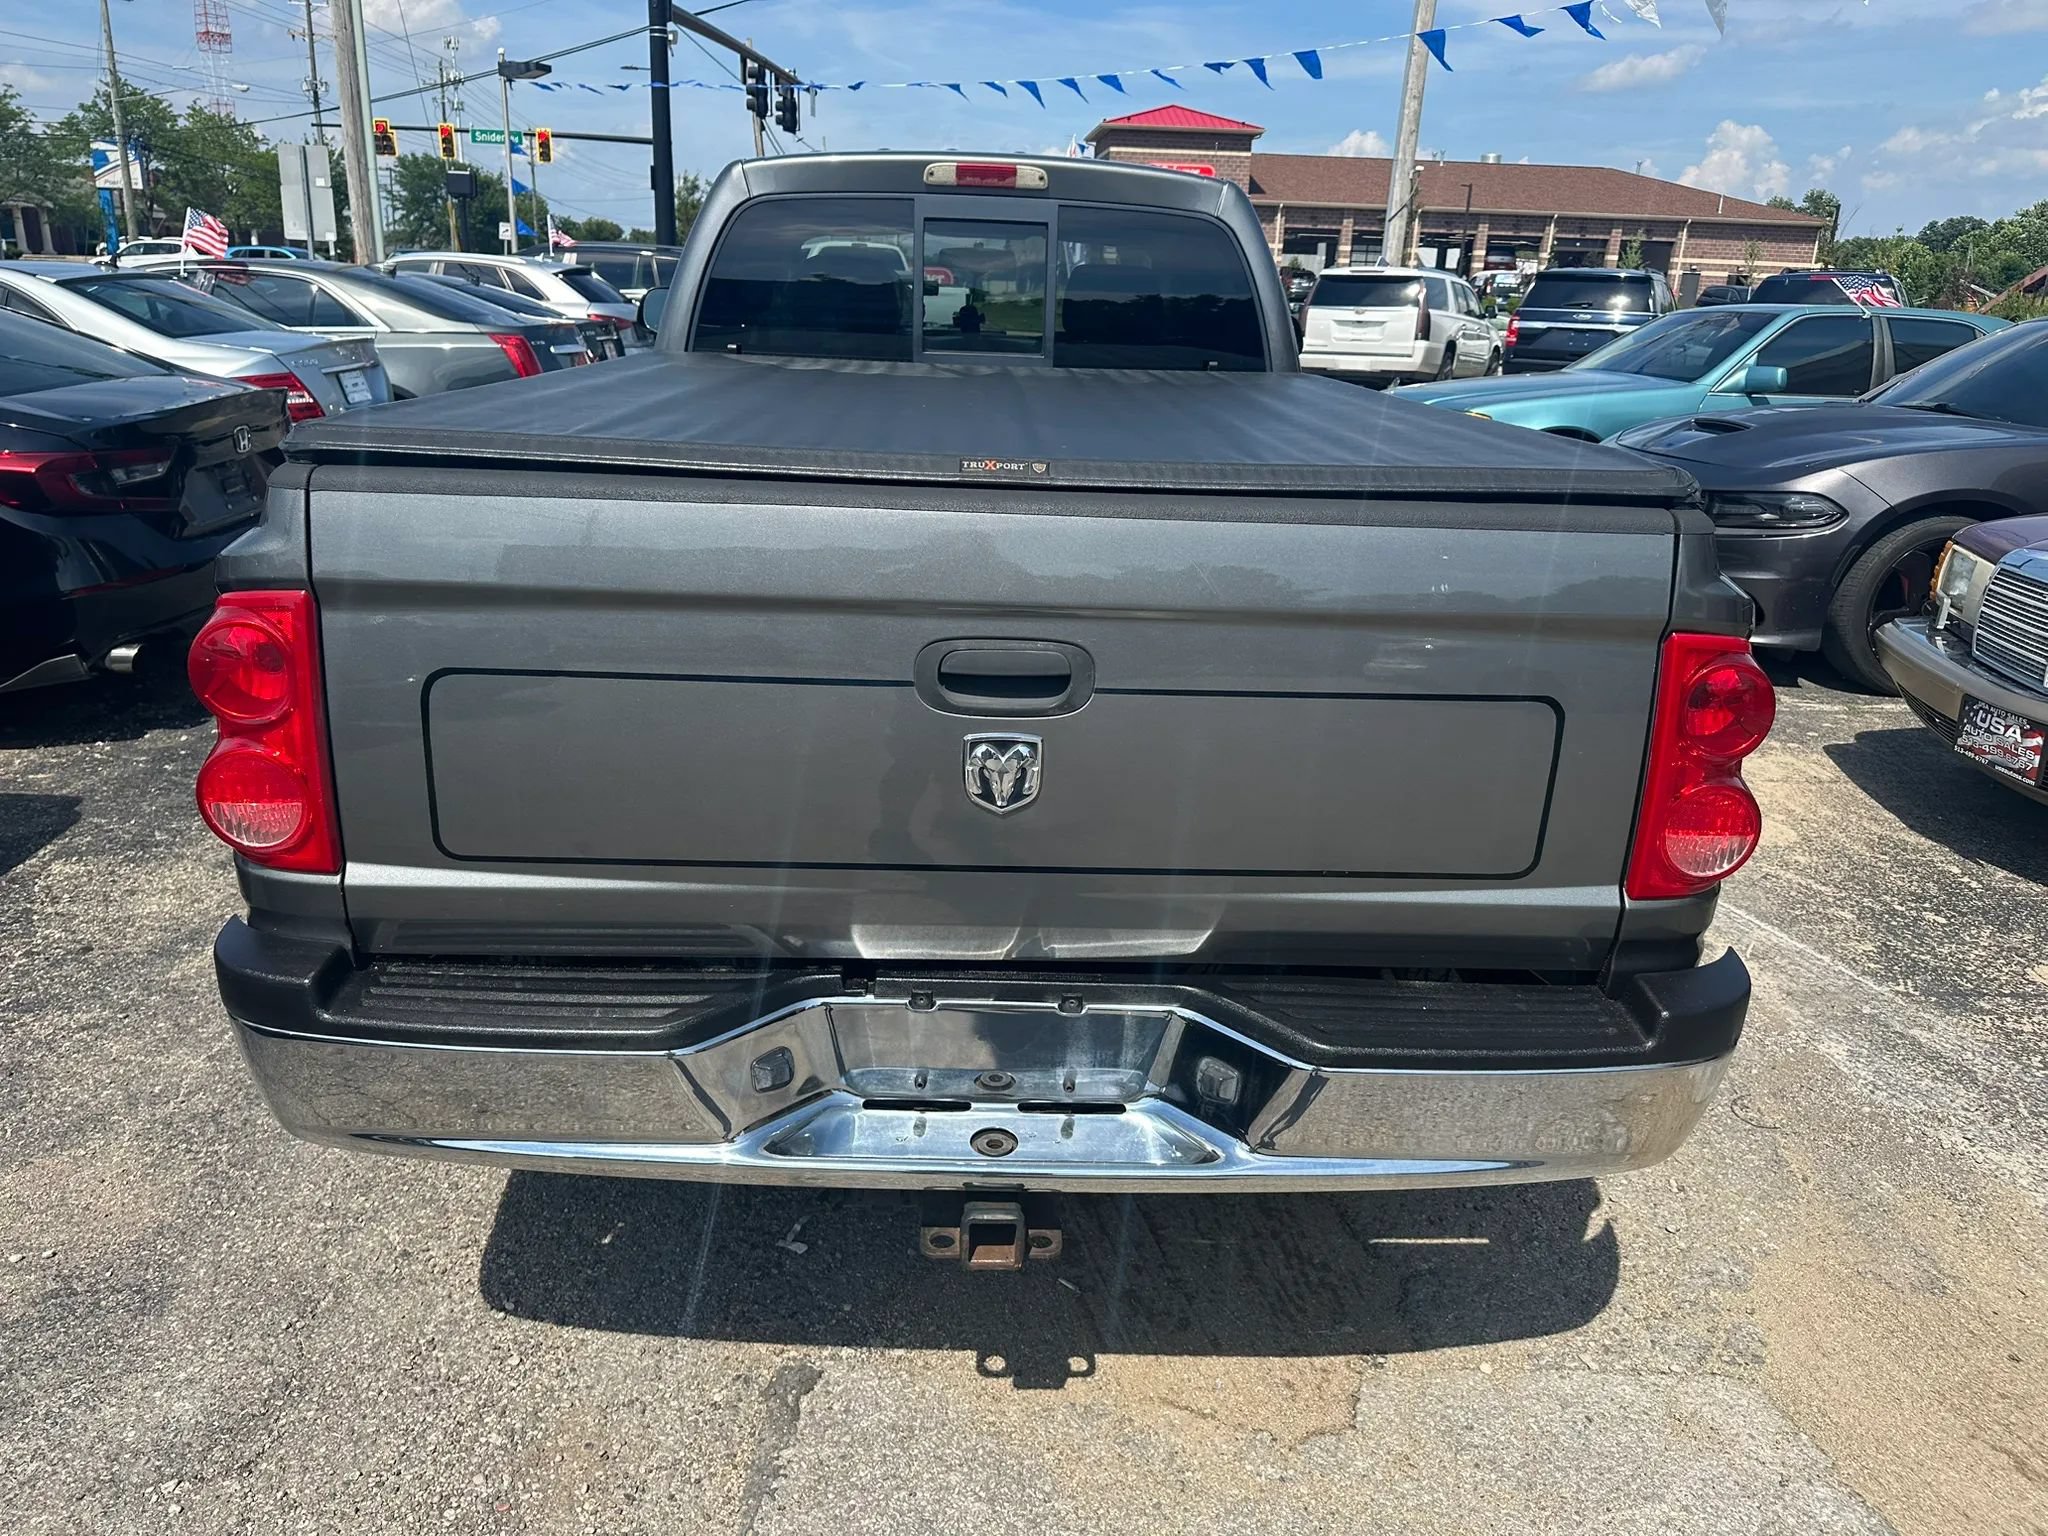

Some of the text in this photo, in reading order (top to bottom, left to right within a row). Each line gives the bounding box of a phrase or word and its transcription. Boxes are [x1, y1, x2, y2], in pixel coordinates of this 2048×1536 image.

[475, 131, 505, 142] Snider
[962, 460, 1025, 471] TRUXPORT
[2007, 712, 2028, 725] SALES
[1976, 709, 2022, 743] USA
[1963, 724, 2035, 760] AUTO SALES
